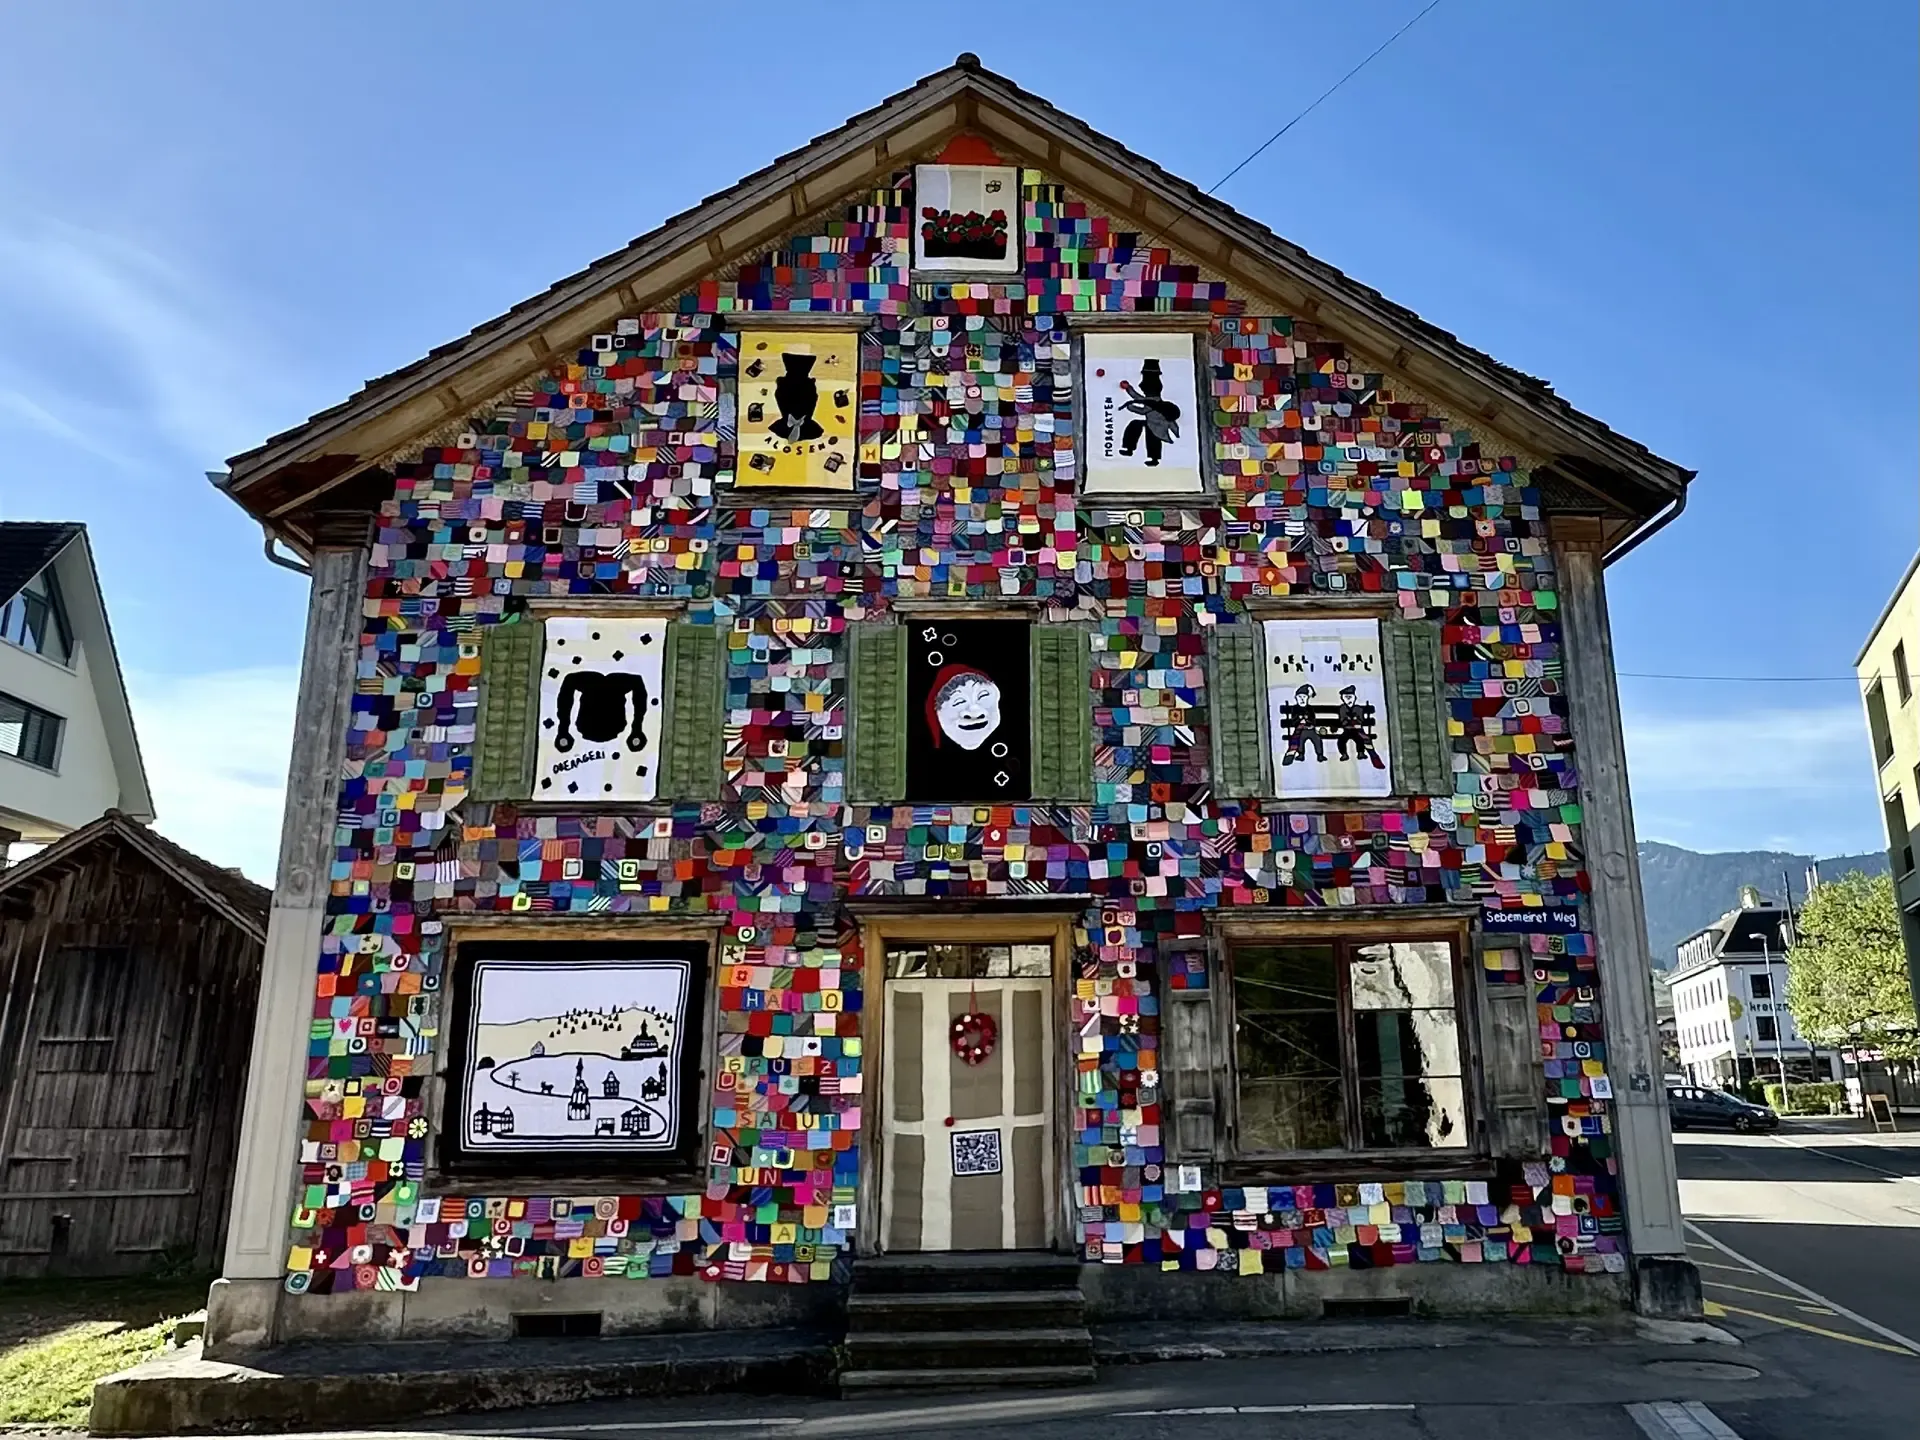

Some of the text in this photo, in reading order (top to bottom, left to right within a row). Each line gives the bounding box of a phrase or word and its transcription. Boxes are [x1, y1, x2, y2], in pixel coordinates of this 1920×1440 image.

[1104, 396, 1114, 457] MORGARTEN
[1553, 912, 1577, 927] Weg
[740, 1111, 835, 1130] SALUT
